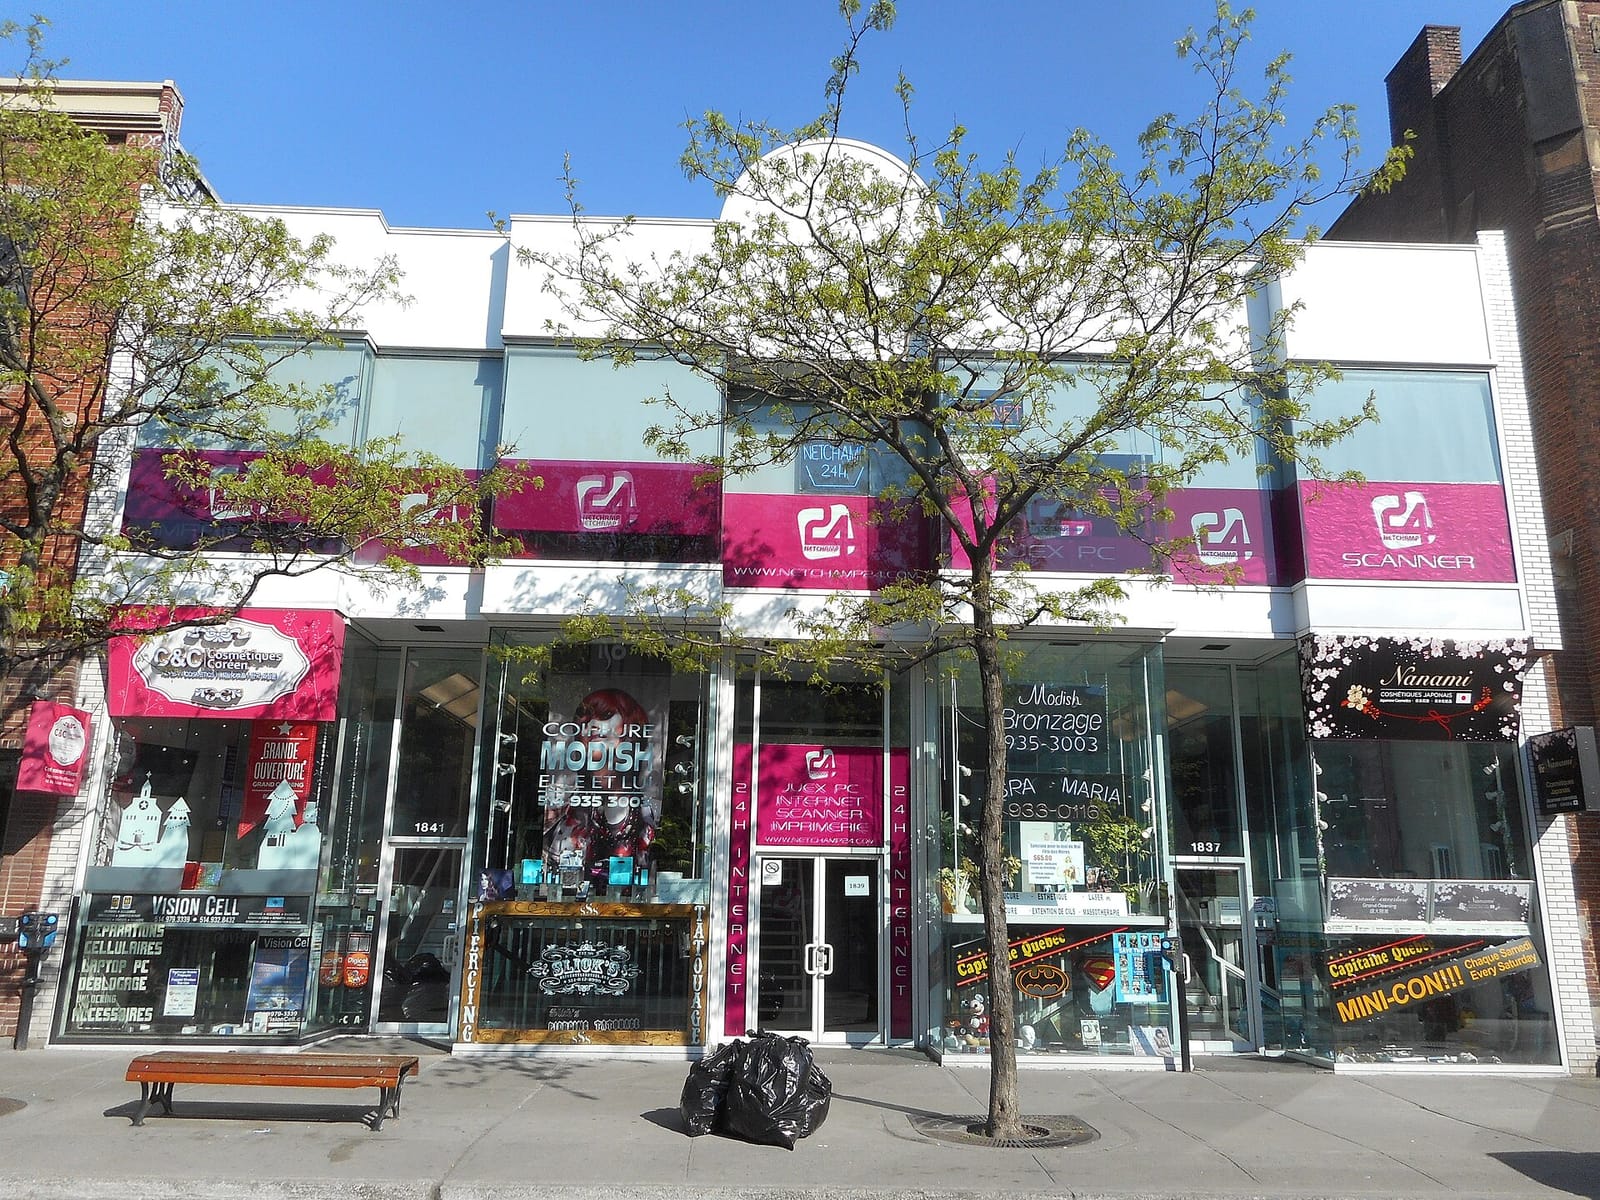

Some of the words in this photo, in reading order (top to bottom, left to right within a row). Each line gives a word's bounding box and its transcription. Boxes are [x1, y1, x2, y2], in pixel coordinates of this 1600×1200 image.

[1078, 546, 1116, 560] PC
[1342, 552, 1475, 569] SCANNER
[153, 646, 202, 669] C&C
[207, 649, 283, 662] Cosmétiques
[1379, 665, 1474, 687] Nanami
[1018, 683, 1083, 708] Modish
[542, 721, 655, 738] COIFFURE
[1002, 707, 1103, 736] Bronzage
[263, 742, 300, 760] GRANDE
[1004, 734, 1099, 753] 935-3003
[539, 740, 655, 772] MODISH
[253, 761, 306, 780] OUVERTURE
[591, 775, 617, 789] ET
[833, 783, 860, 795] PC
[1061, 776, 1121, 806] MARIA
[569, 795, 603, 808] 935
[775, 795, 864, 807] INTERNET
[775, 807, 864, 820] SCANNER
[414, 822, 444, 833] 1841
[1190, 841, 1222, 854] 1837
[152, 895, 200, 917] VISION
[204, 895, 240, 917] CELL
[83, 940, 164, 956] CELLULAIRES
[263, 937, 292, 949] Vision
[1328, 950, 1389, 979] Capitaine
[1464, 951, 1499, 970] Chaque
[1500, 941, 1533, 958] Samedi
[133, 959, 150, 974] PC
[462, 902, 485, 1043] PIERCING
[551, 957, 621, 978] SLICK'S
[690, 904, 707, 1045] TATOUAGE
[1469, 966, 1498, 982] Every
[1498, 952, 1538, 972] Saturday
[1335, 964, 1465, 1024] MINI-CON!!!
[71, 1006, 154, 1022] ACCESSOIRES
